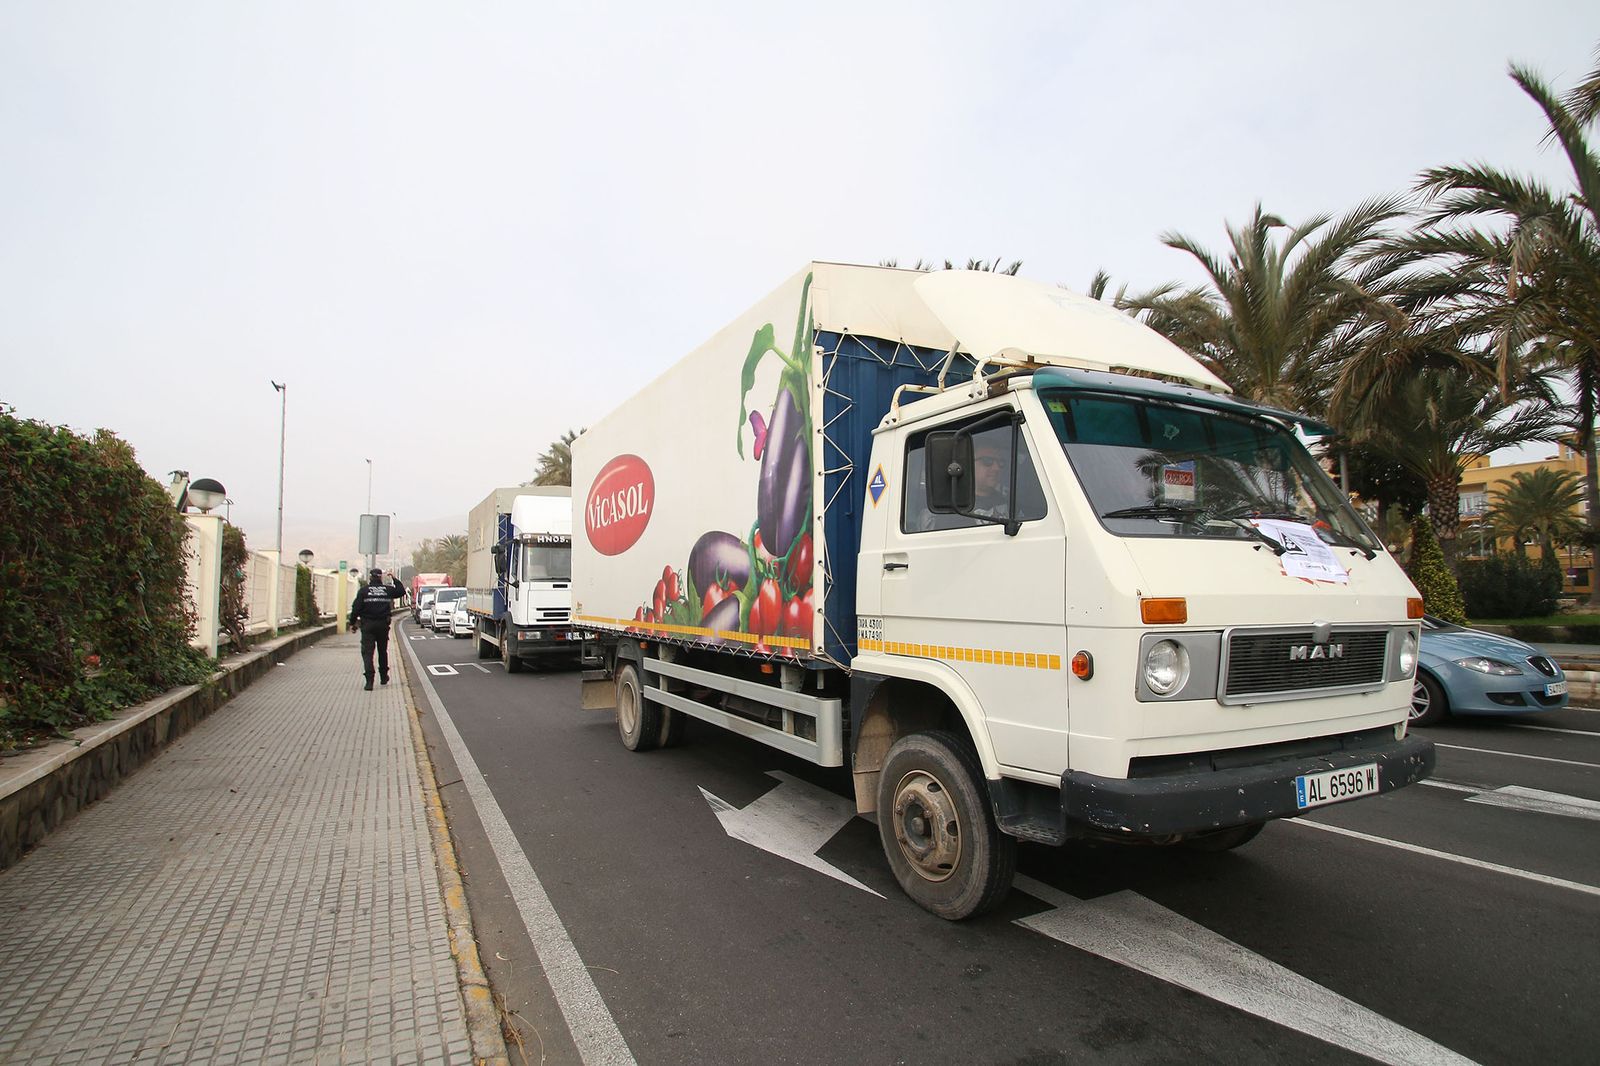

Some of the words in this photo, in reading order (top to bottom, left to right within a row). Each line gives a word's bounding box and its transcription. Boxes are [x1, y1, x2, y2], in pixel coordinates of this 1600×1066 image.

[1290, 644, 1343, 660] MAN
[1309, 778, 1327, 803] AL
[1330, 771, 1363, 798] 6596
[1366, 768, 1374, 791] W
